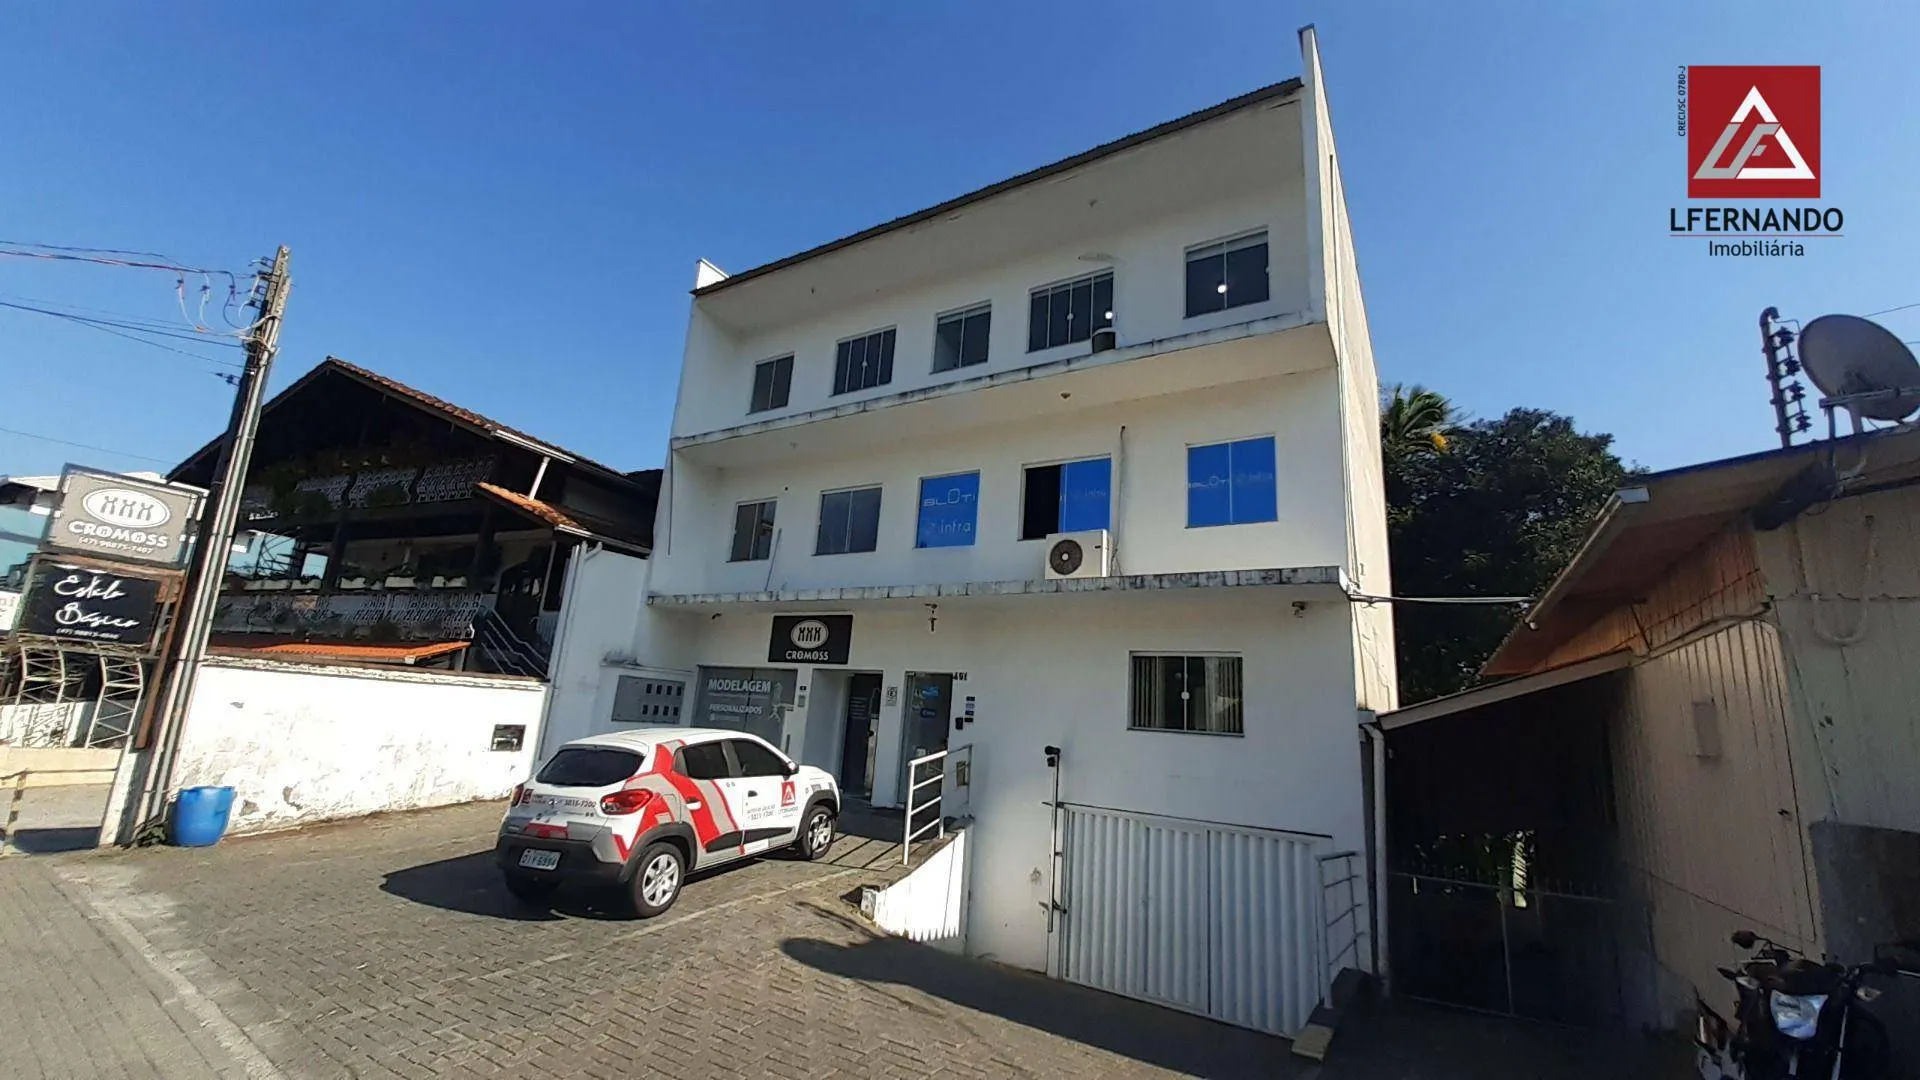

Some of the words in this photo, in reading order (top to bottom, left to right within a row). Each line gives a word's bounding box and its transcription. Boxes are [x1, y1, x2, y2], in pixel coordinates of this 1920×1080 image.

[67, 520, 169, 548] CROMOSS
[785, 650, 829, 661] CROMOSS
[707, 678, 771, 694] MODELAGEM
